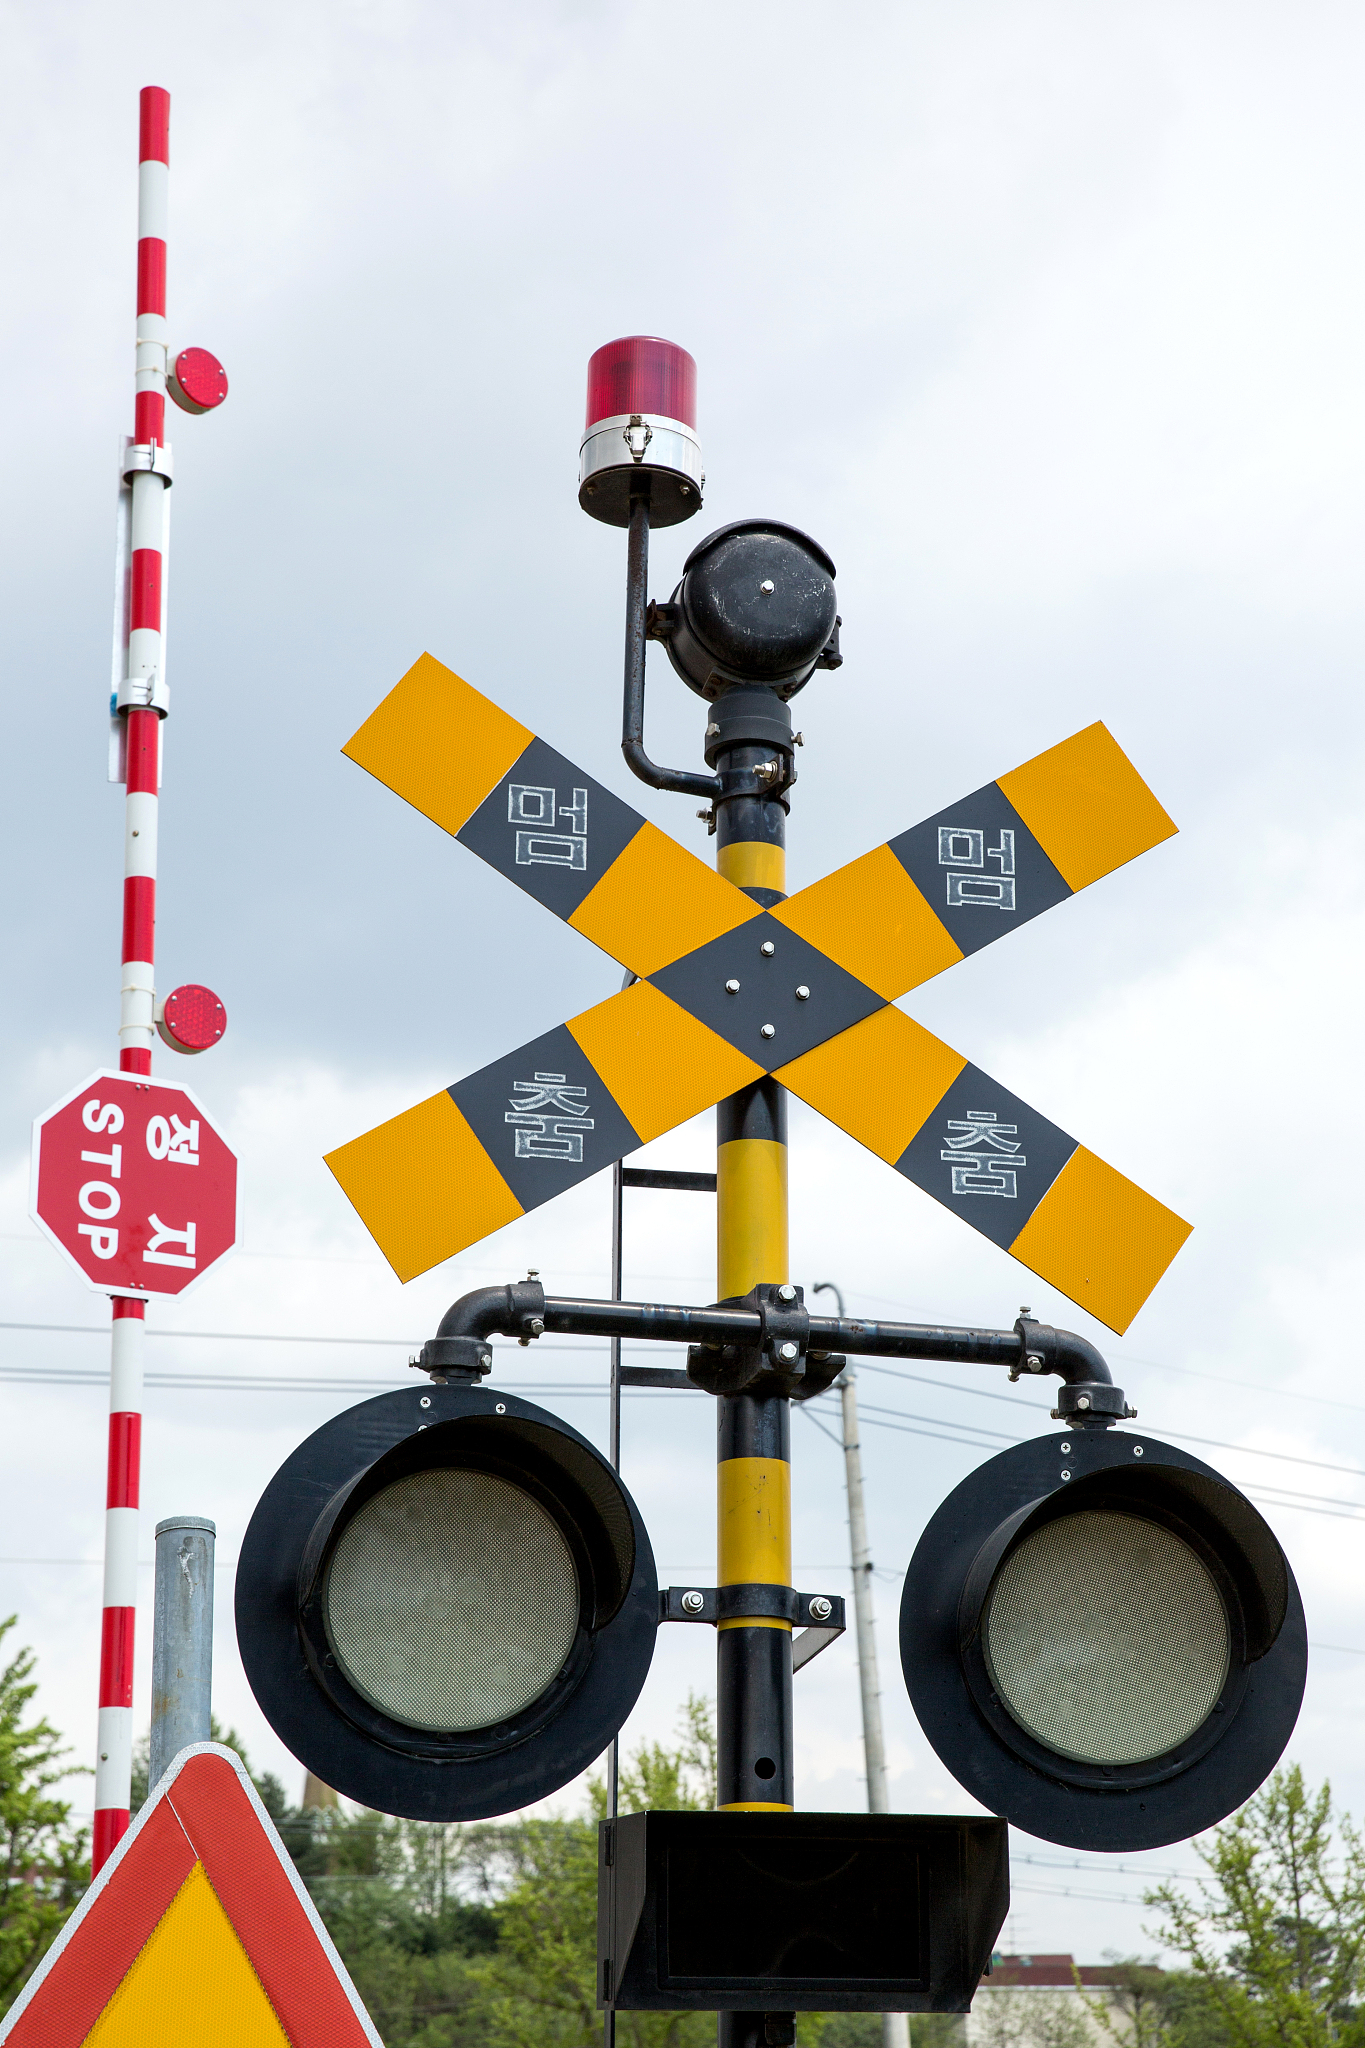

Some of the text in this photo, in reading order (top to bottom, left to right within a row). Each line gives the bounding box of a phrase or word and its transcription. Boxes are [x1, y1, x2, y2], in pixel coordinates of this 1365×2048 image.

[507, 783, 588, 871] 멈
[937, 826, 1016, 911] 멈
[504, 1071, 595, 1163] 춤
[939, 1110, 1027, 1199] 춤
[77, 1099, 125, 1260] STOP
